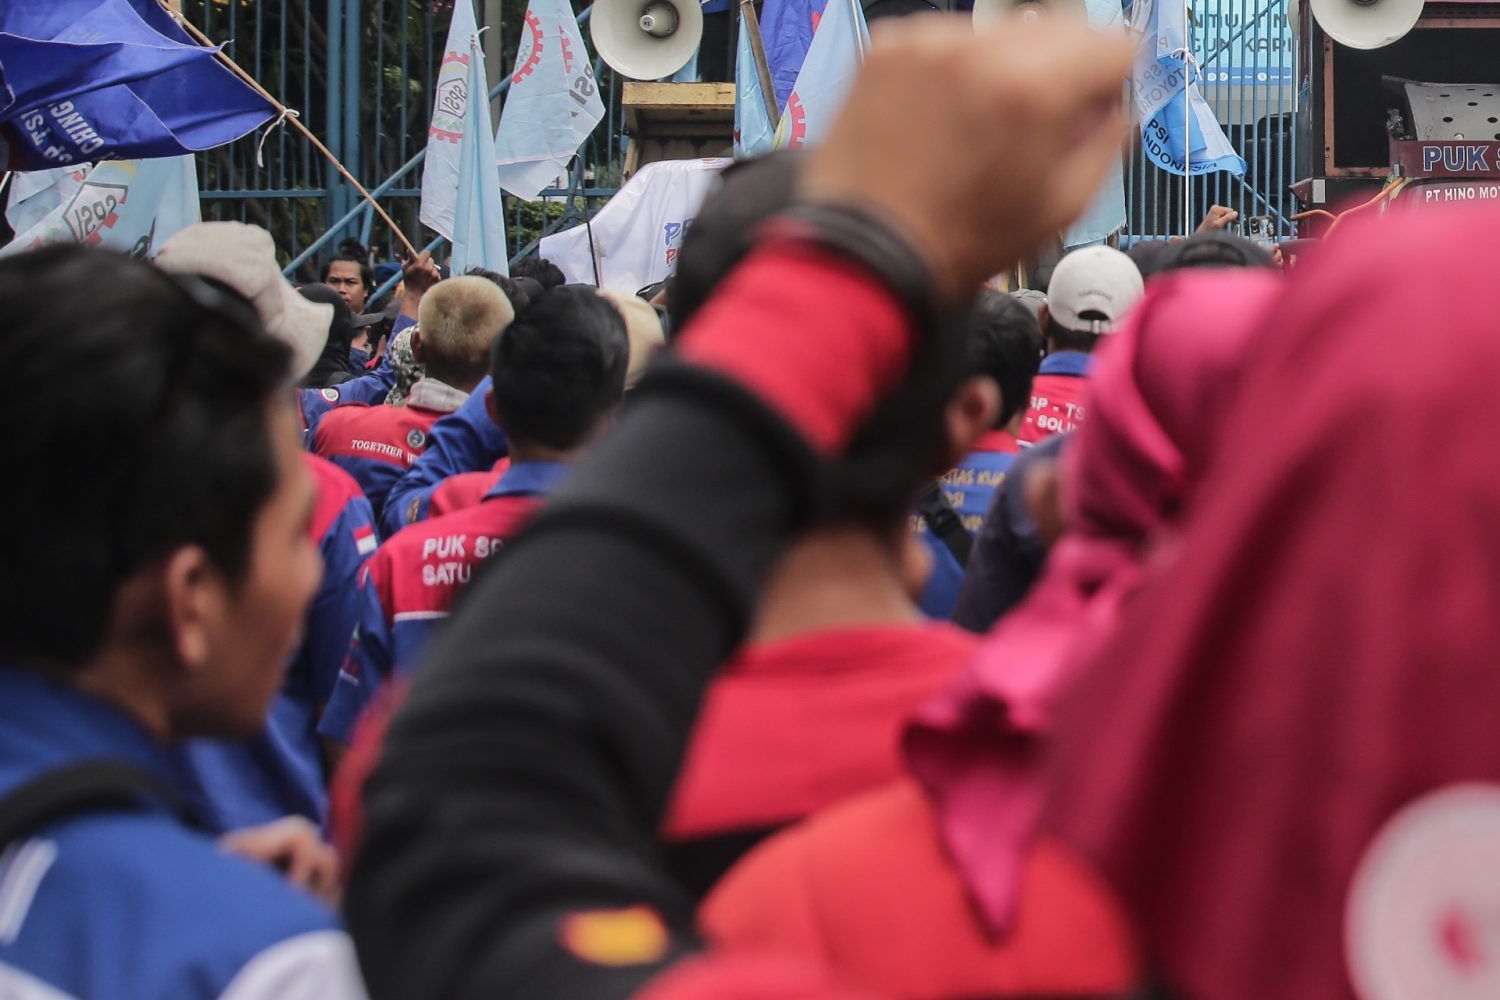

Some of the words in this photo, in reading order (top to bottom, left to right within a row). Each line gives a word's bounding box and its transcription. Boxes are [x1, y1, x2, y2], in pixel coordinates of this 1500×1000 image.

[1423, 145, 1489, 172] PUK
[1426, 189, 1440, 202] PT
[1444, 187, 1475, 201] HINO
[352, 439, 403, 459] TOGETHER
[422, 535, 466, 560] PUK
[422, 562, 471, 586] SATU
